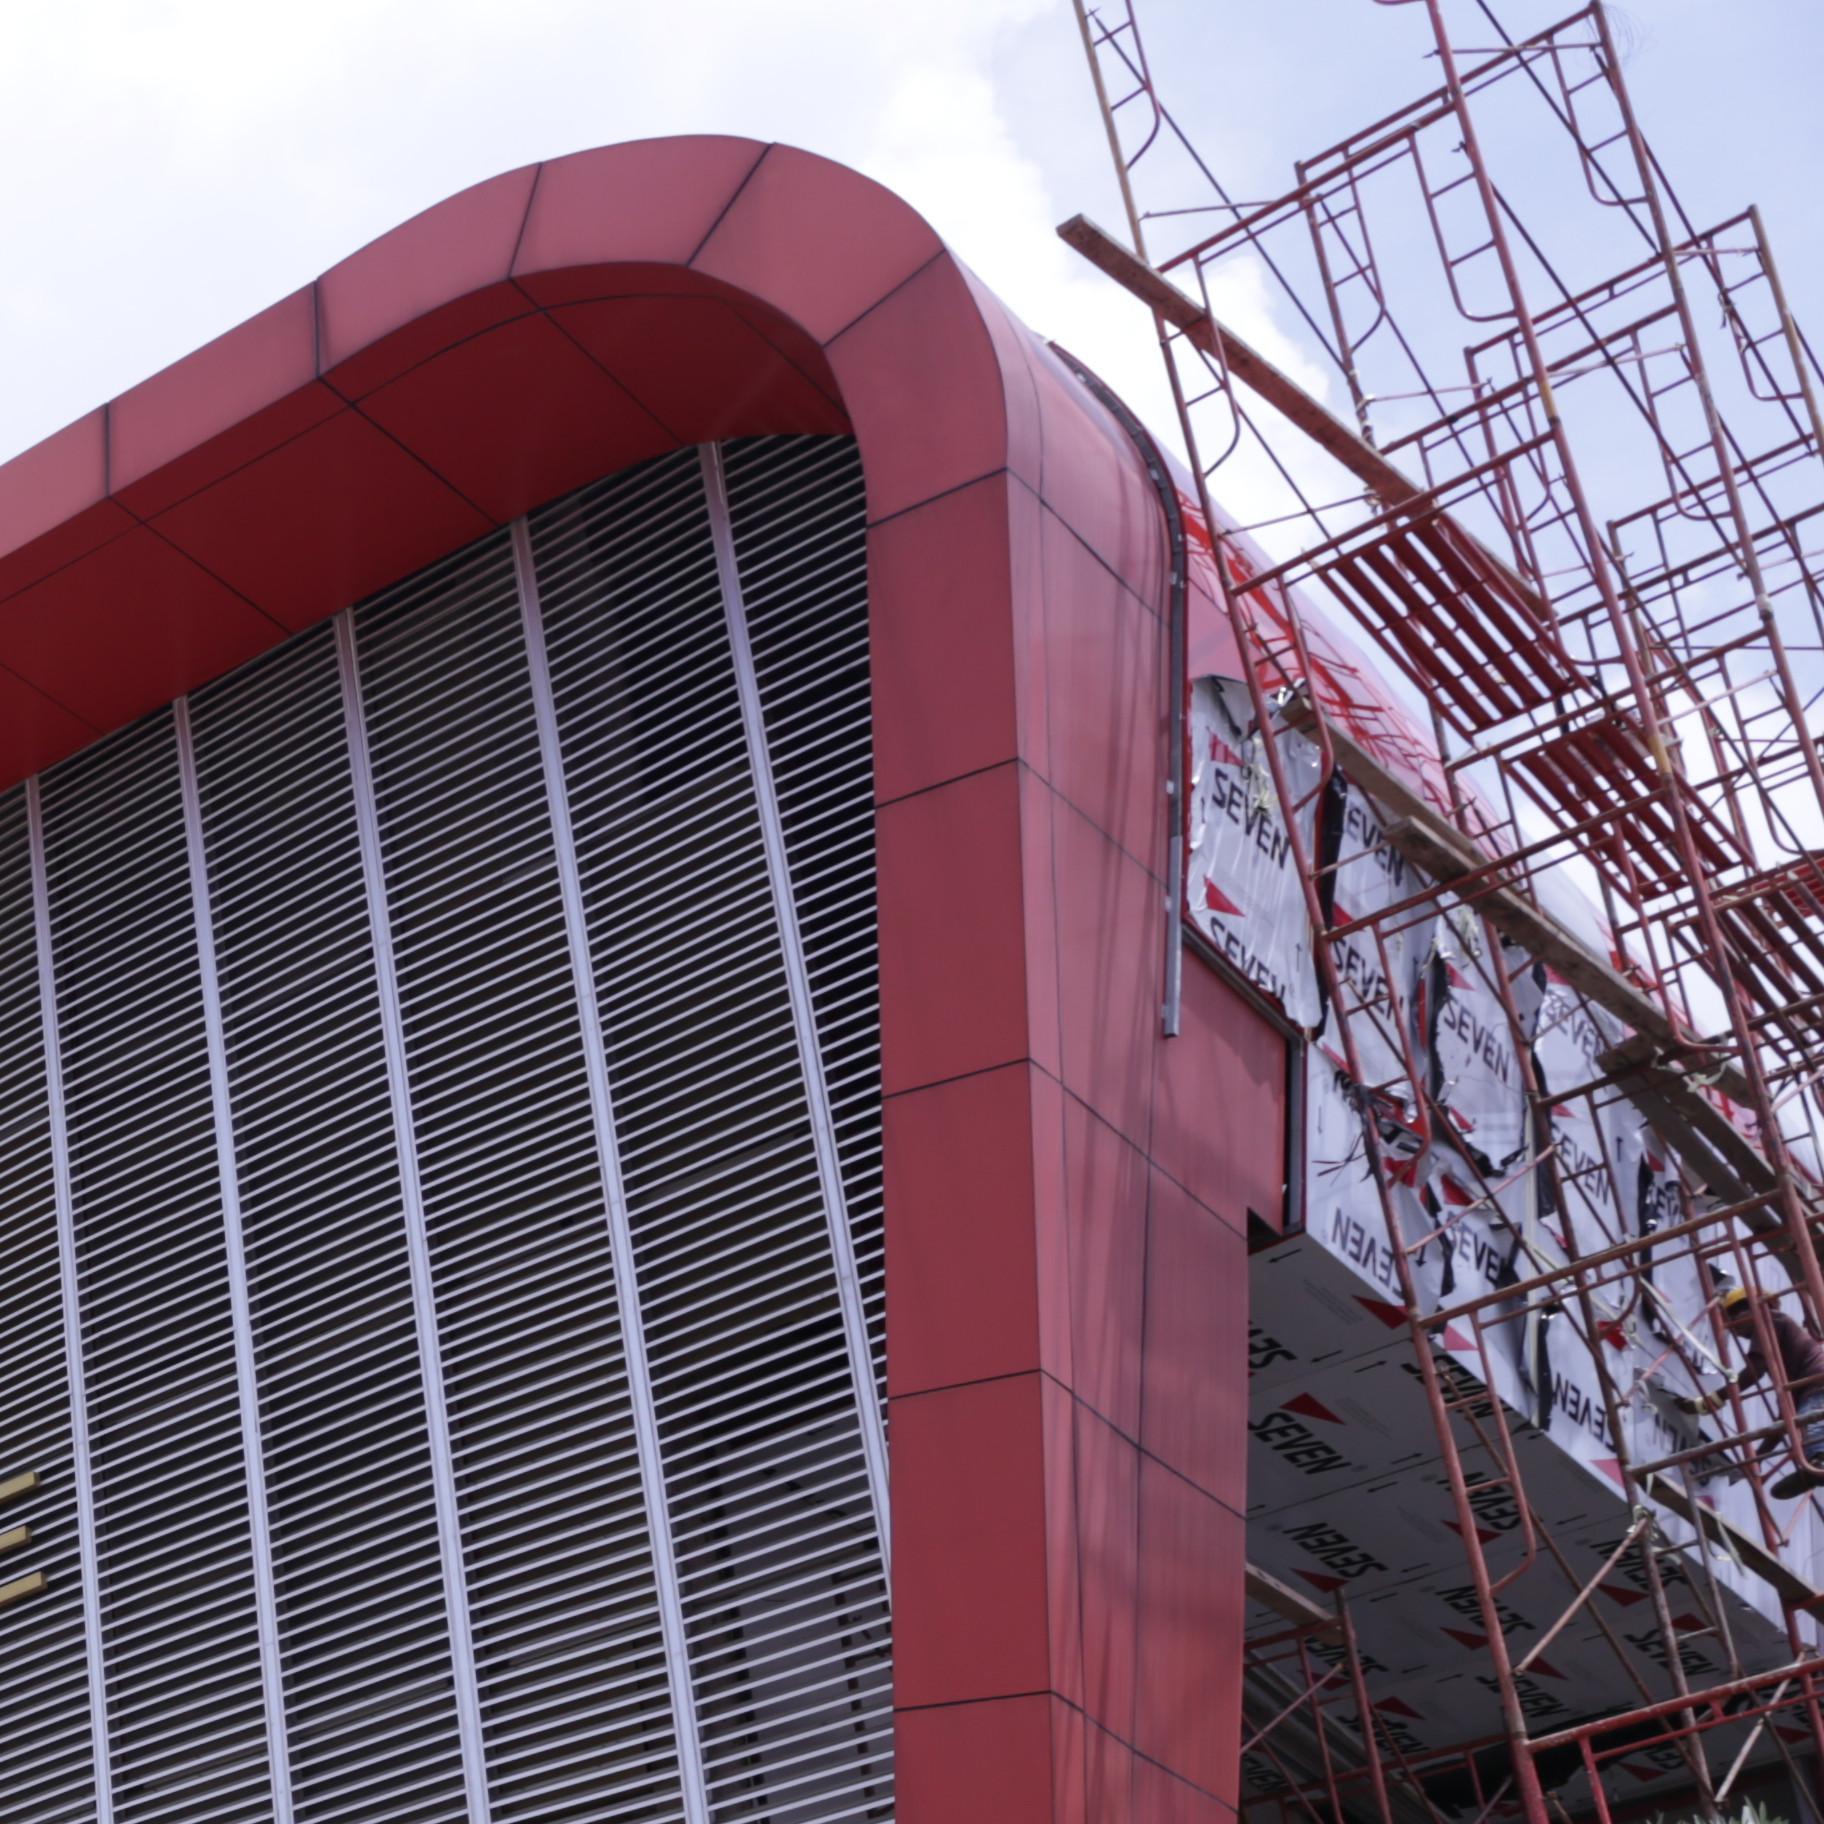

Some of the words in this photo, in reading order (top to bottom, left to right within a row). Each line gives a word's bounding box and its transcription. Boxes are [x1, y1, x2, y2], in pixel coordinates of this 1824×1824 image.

[1211, 768, 1289, 870] SEVEN
[1444, 998, 1511, 1082] SEVEN
[1249, 1412, 1350, 1475] SEVEN
[1282, 1522, 1388, 1579] SEVEN
